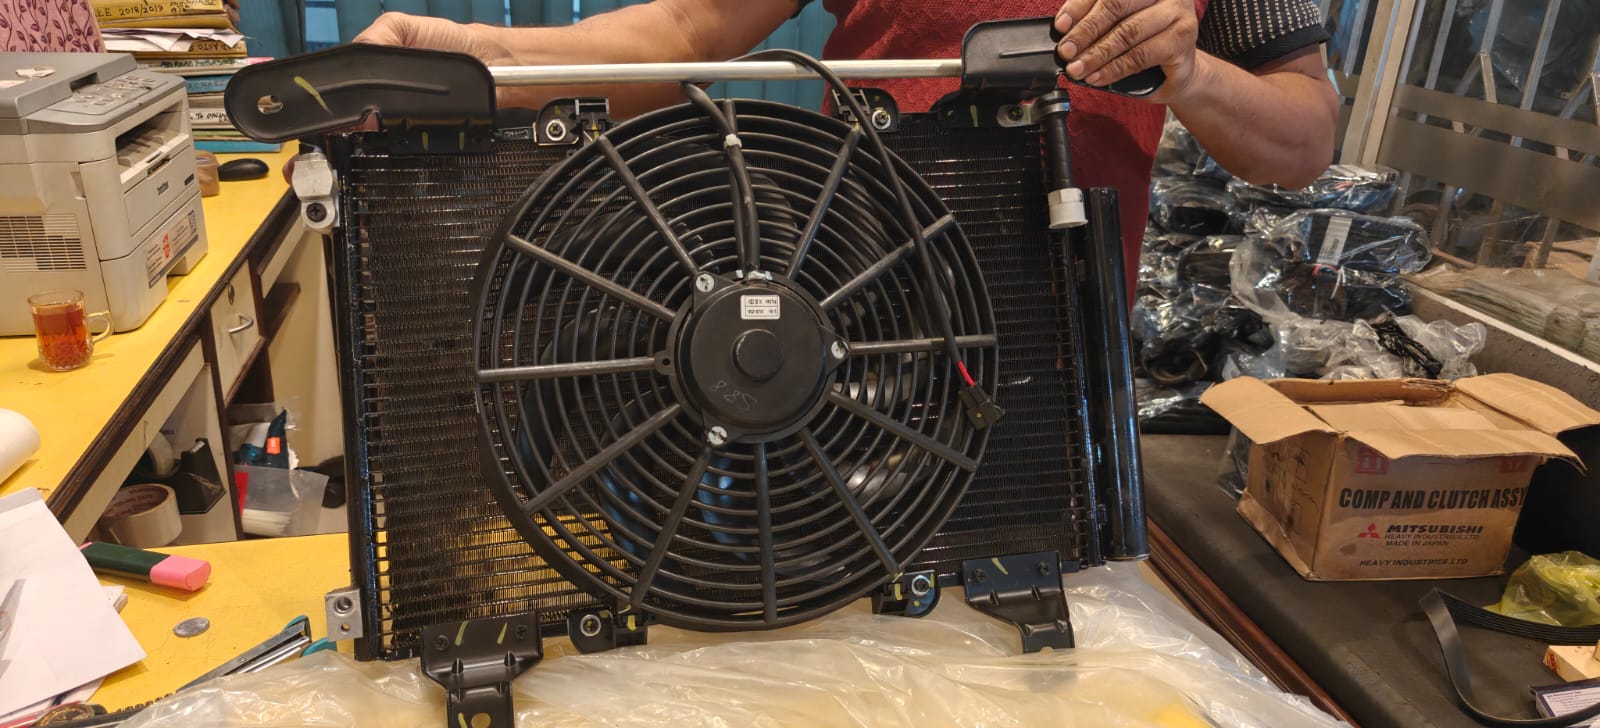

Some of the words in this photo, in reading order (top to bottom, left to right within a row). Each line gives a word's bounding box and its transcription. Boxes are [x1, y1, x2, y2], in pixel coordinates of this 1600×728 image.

[1339, 488, 1390, 509] COMP
[1390, 490, 1427, 509] AND
[1428, 489, 1491, 509] CLUTCH
[1490, 487, 1528, 508] ASSY
[1386, 525, 1484, 534] MITSUBISHI
[1360, 559, 1393, 567] HEAVY
